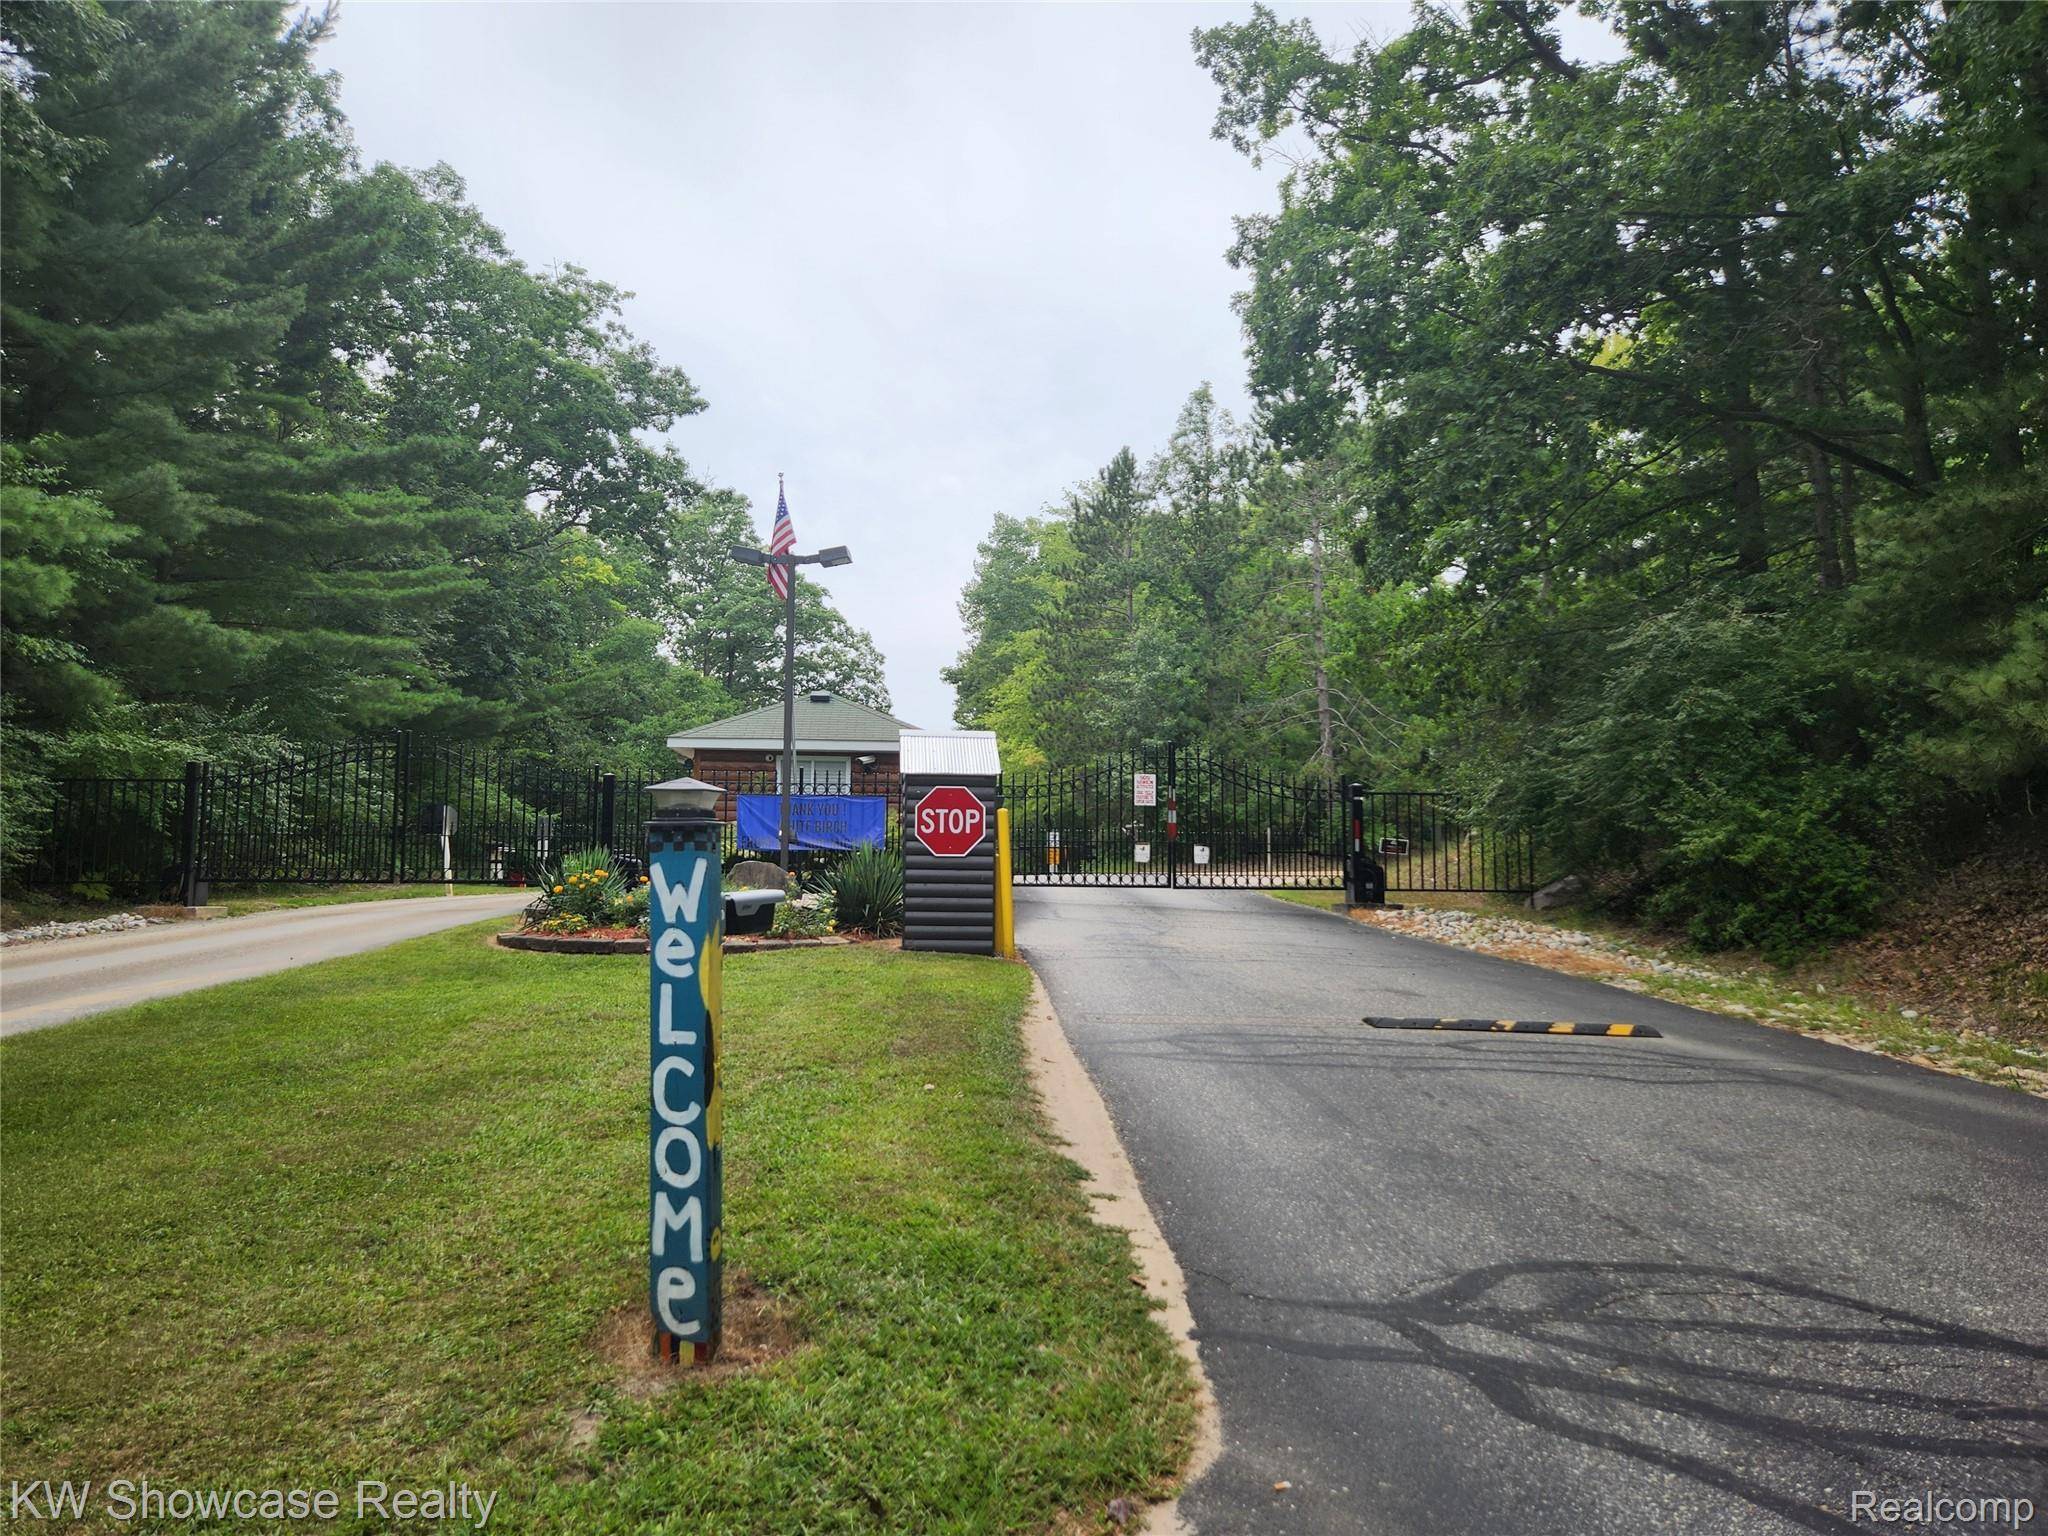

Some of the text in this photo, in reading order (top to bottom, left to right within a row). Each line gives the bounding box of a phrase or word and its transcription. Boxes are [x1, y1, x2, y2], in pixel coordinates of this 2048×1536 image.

[789, 803, 814, 816] ANK
[817, 803, 839, 816] YOU
[814, 819, 848, 833] BIRCH
[920, 808, 980, 834] STOP
